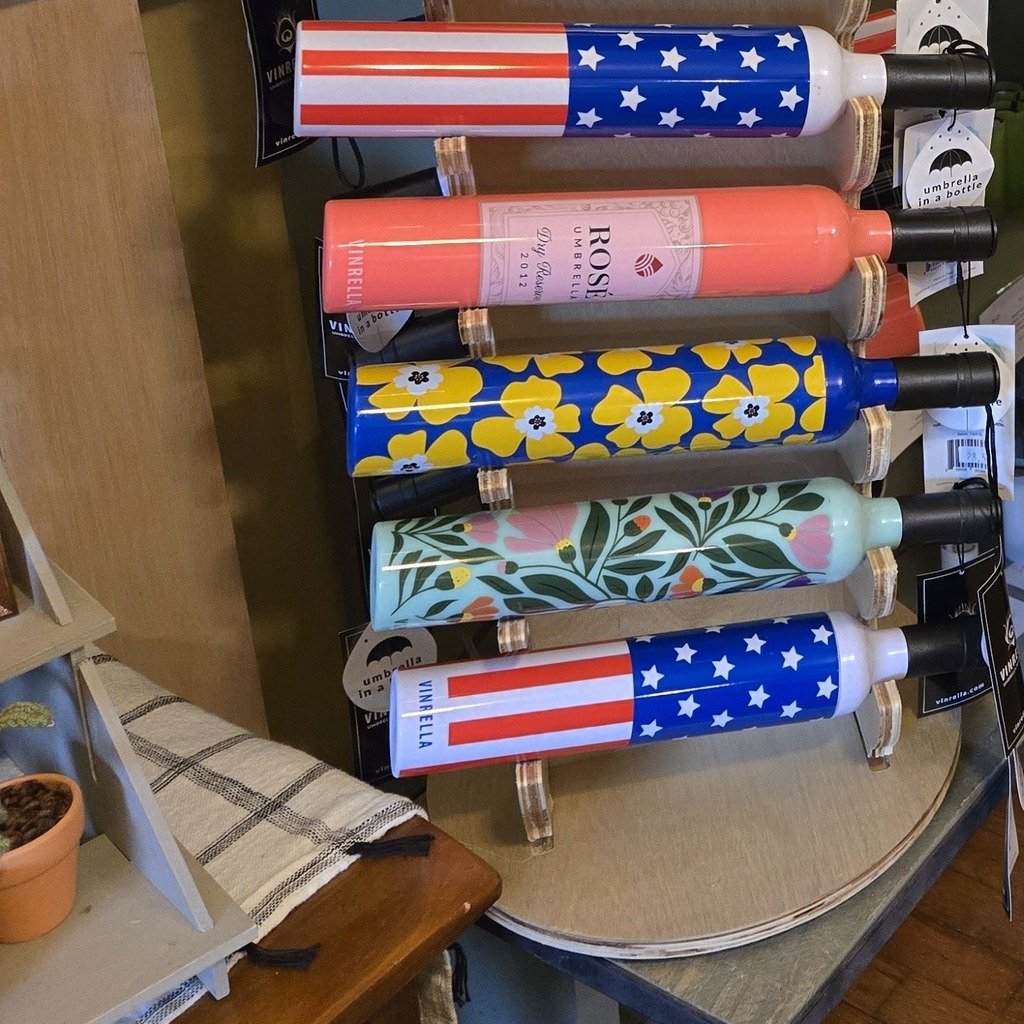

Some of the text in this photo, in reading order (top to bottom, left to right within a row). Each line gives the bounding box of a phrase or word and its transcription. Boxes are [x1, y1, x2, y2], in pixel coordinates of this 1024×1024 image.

[266, 57, 296, 84] VINR
[918, 181, 983, 208] in a bottle
[923, 173, 979, 195] umbrella
[346, 238, 365, 307] VINRELLA
[518, 252, 530, 288] 2012
[357, 684, 385, 699] in a
[935, 682, 986, 706] vinrella.com
[418, 680, 434, 750] VINRELLA
